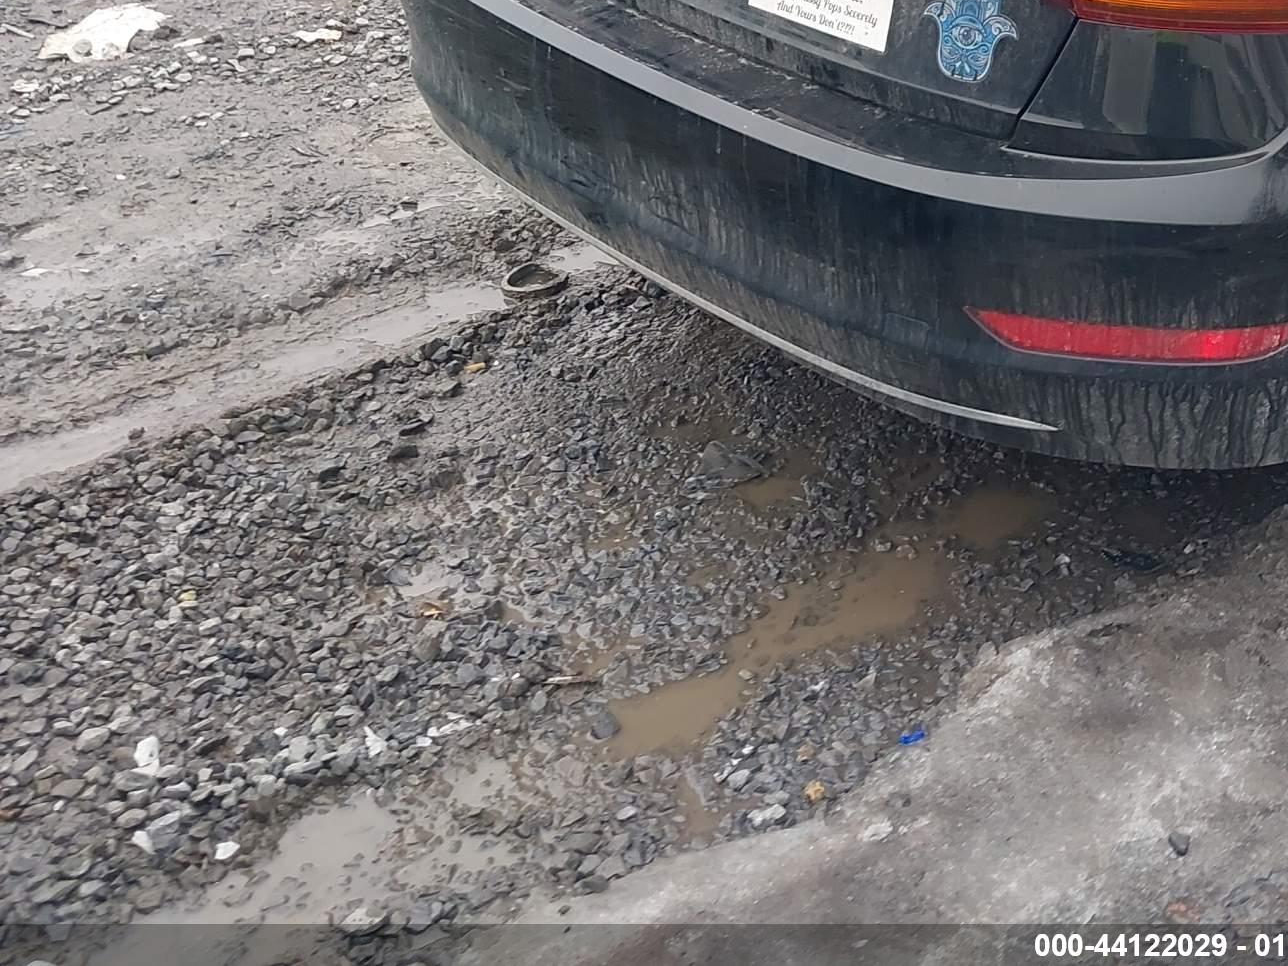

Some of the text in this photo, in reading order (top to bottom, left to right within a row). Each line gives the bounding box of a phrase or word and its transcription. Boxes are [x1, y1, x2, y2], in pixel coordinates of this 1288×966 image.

[777, 0, 793, 14] And
[795, 6, 816, 23] Yours
[844, 5, 878, 27] Severely
